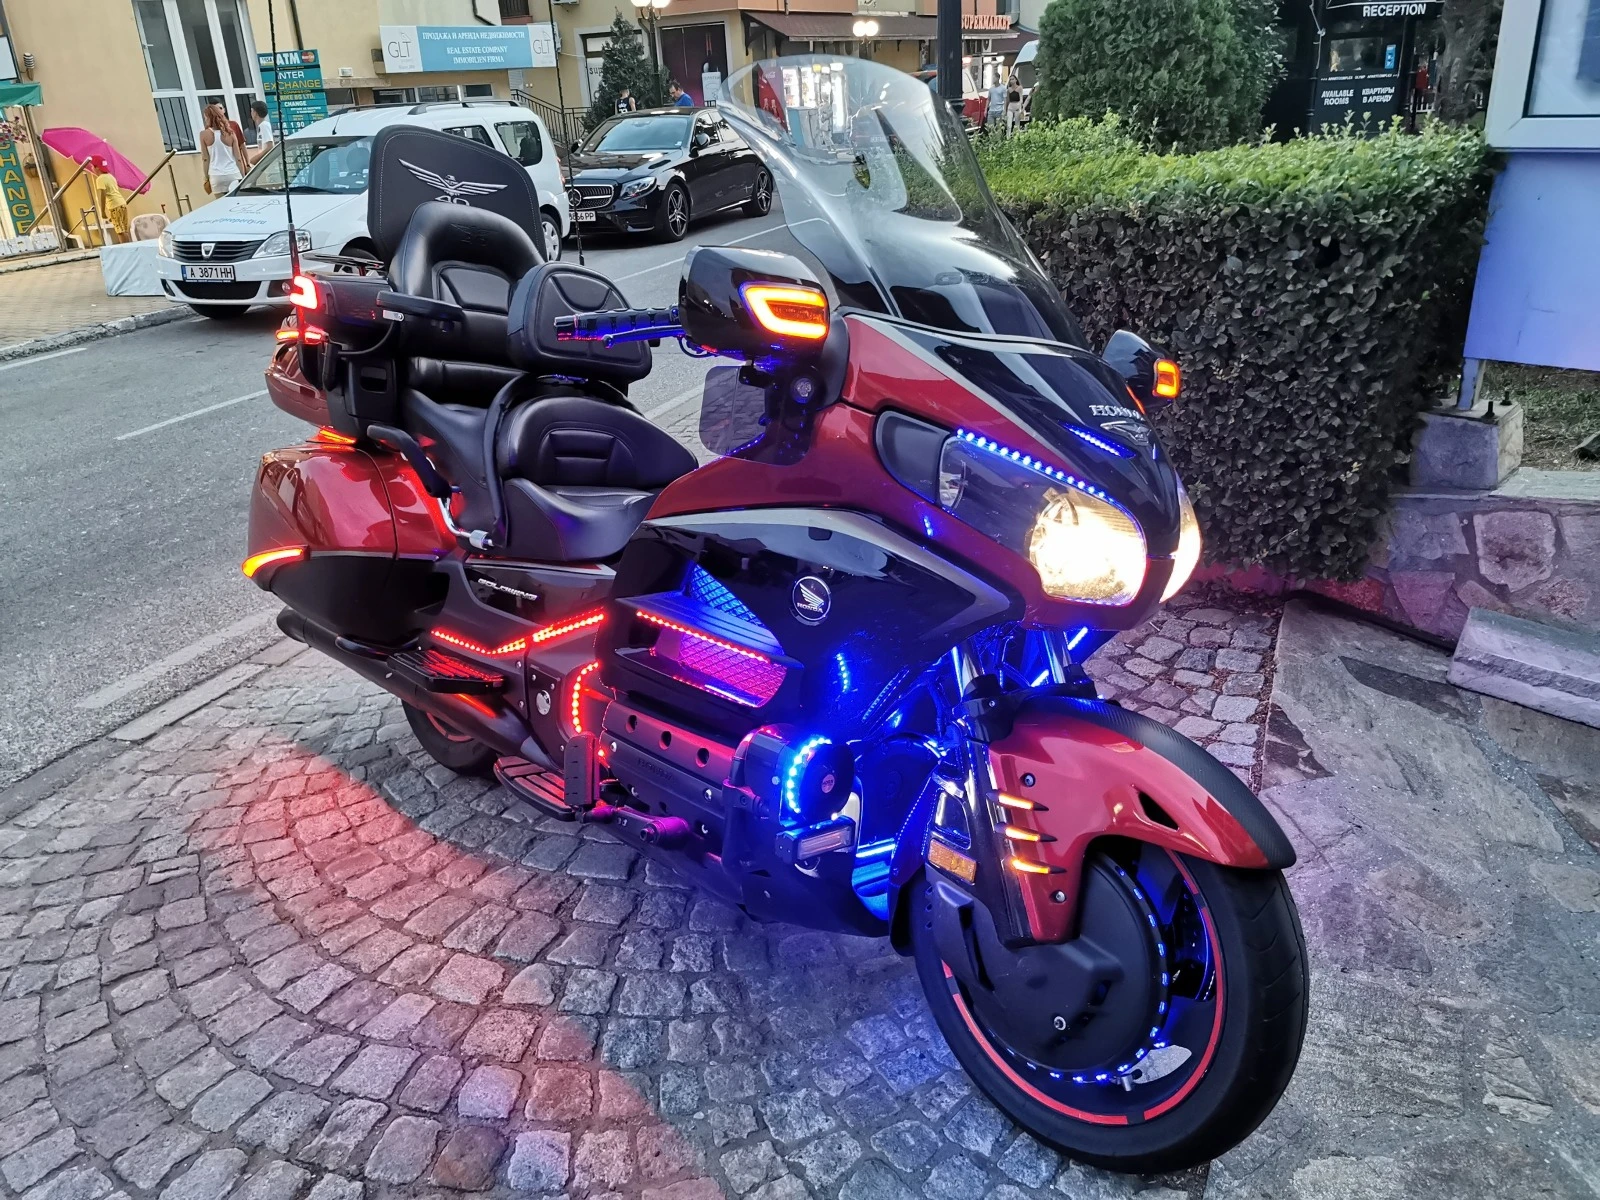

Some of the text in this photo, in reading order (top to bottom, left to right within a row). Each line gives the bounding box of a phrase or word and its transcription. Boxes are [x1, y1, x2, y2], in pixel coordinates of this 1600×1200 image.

[1362, 3, 1427, 17] RECEPTION
[422, 31, 525, 41] ПРОДАЖА И АРЕНДА НЕДВИЖИМОСТИ
[387, 41, 412, 58] GLT
[446, 45, 508, 55] REAL ESTATE COMPANY
[276, 52, 300, 66] ATM
[453, 55, 505, 64] IMMOBILIEN FIRMA
[277, 71, 305, 80] NTER
[263, 79, 322, 91] EXCHANGE
[1321, 89, 1354, 98] AVAILABLE
[1361, 86, 1395, 96] КВАРТИРЫ
[1323, 97, 1350, 106] ROOMS
[1362, 94, 1393, 104] В АРЕНДУ
[190, 267, 196, 278] A
